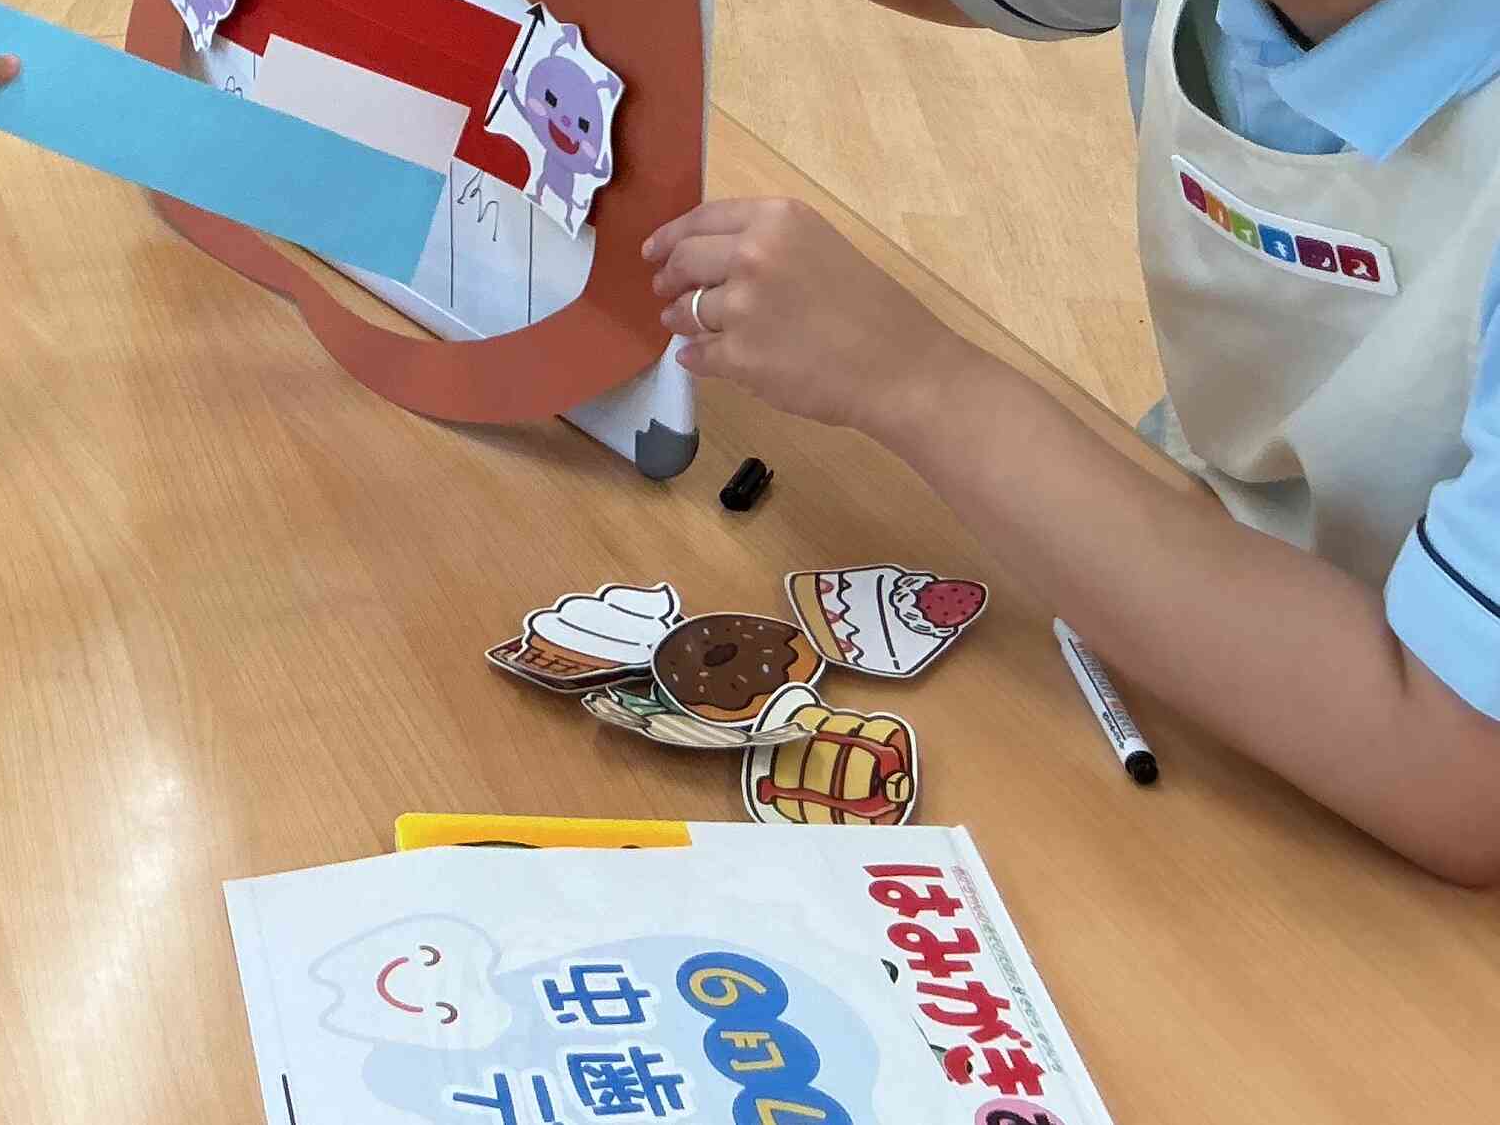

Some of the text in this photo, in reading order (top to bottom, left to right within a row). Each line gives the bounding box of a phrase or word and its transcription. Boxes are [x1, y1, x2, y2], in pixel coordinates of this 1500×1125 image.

[543, 963, 685, 1117] 虫歯
[863, 864, 1046, 1096] はみがき
